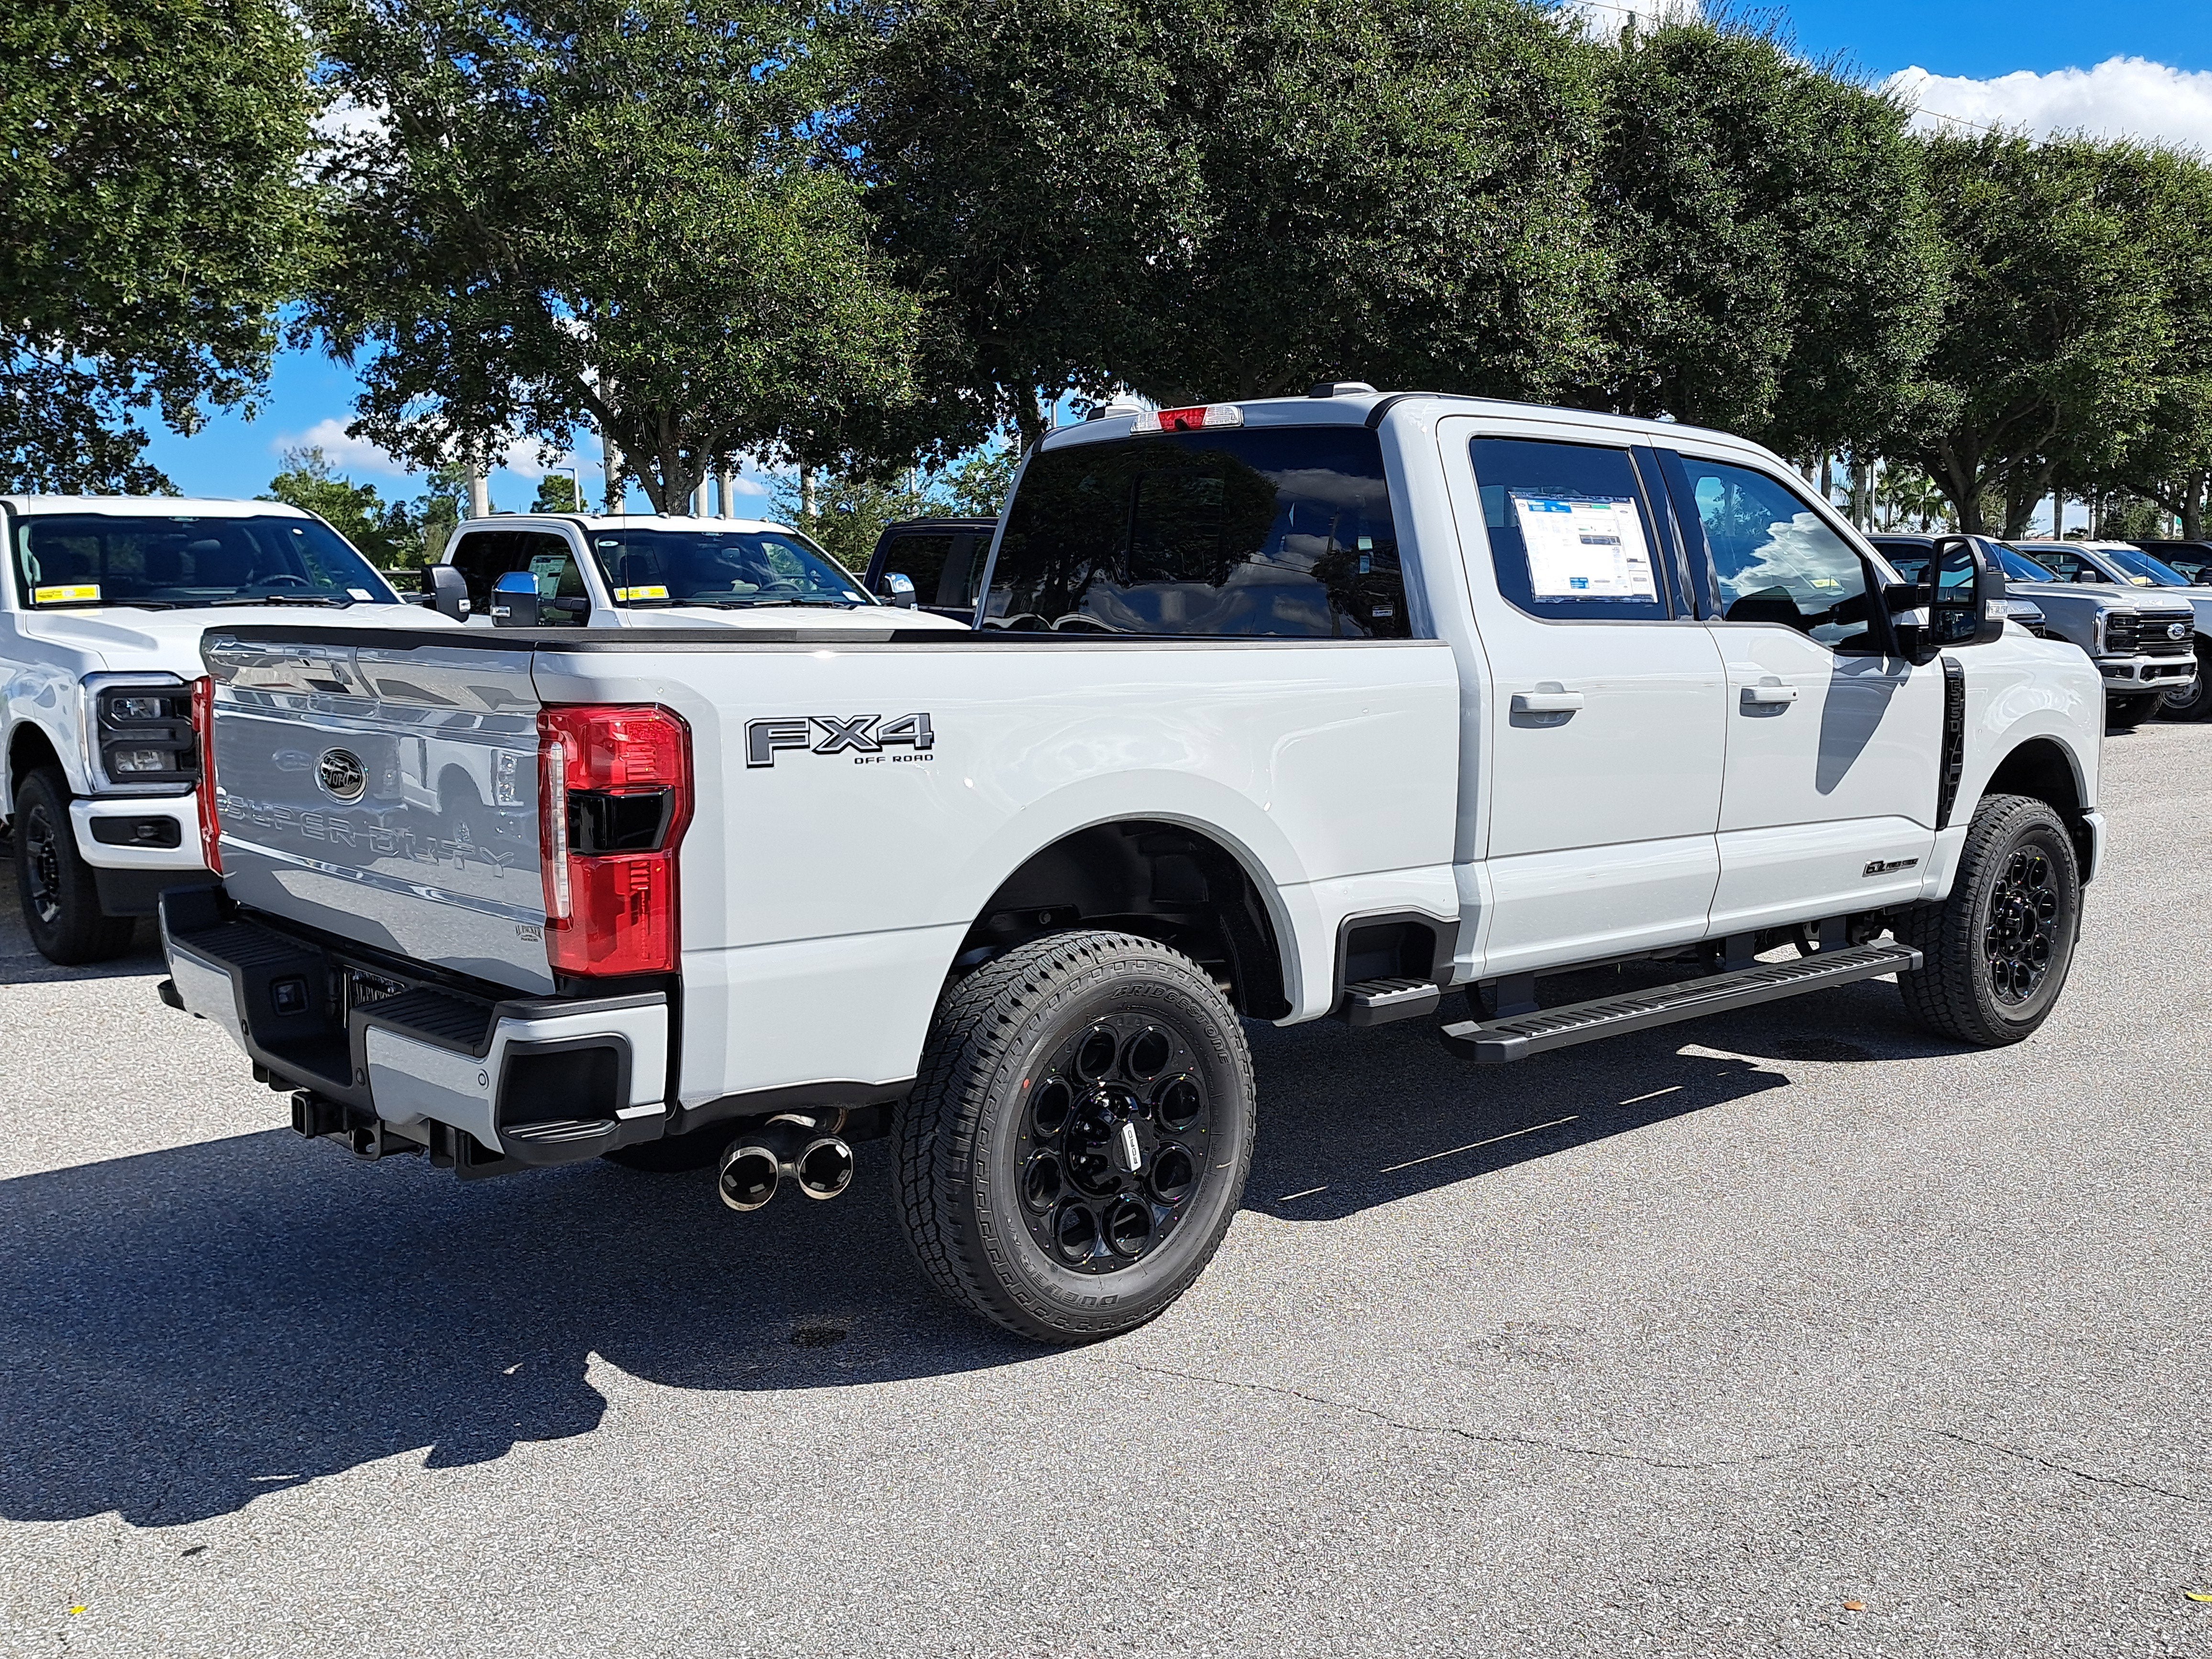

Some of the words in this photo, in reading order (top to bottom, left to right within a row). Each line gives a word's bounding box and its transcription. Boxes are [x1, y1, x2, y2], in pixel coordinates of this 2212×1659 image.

[745, 713, 934, 768] FX4
[854, 756, 886, 764] OFF
[893, 754, 934, 763] ROAD
[322, 755, 358, 787] Ford
[215, 794, 357, 848] SUPER
[369, 825, 514, 879] DUTY
[1110, 982, 1232, 1064] BRIDGESTONE
[1128, 1130, 1138, 1164] FORD
[1019, 1253, 1120, 1309] DUELER
